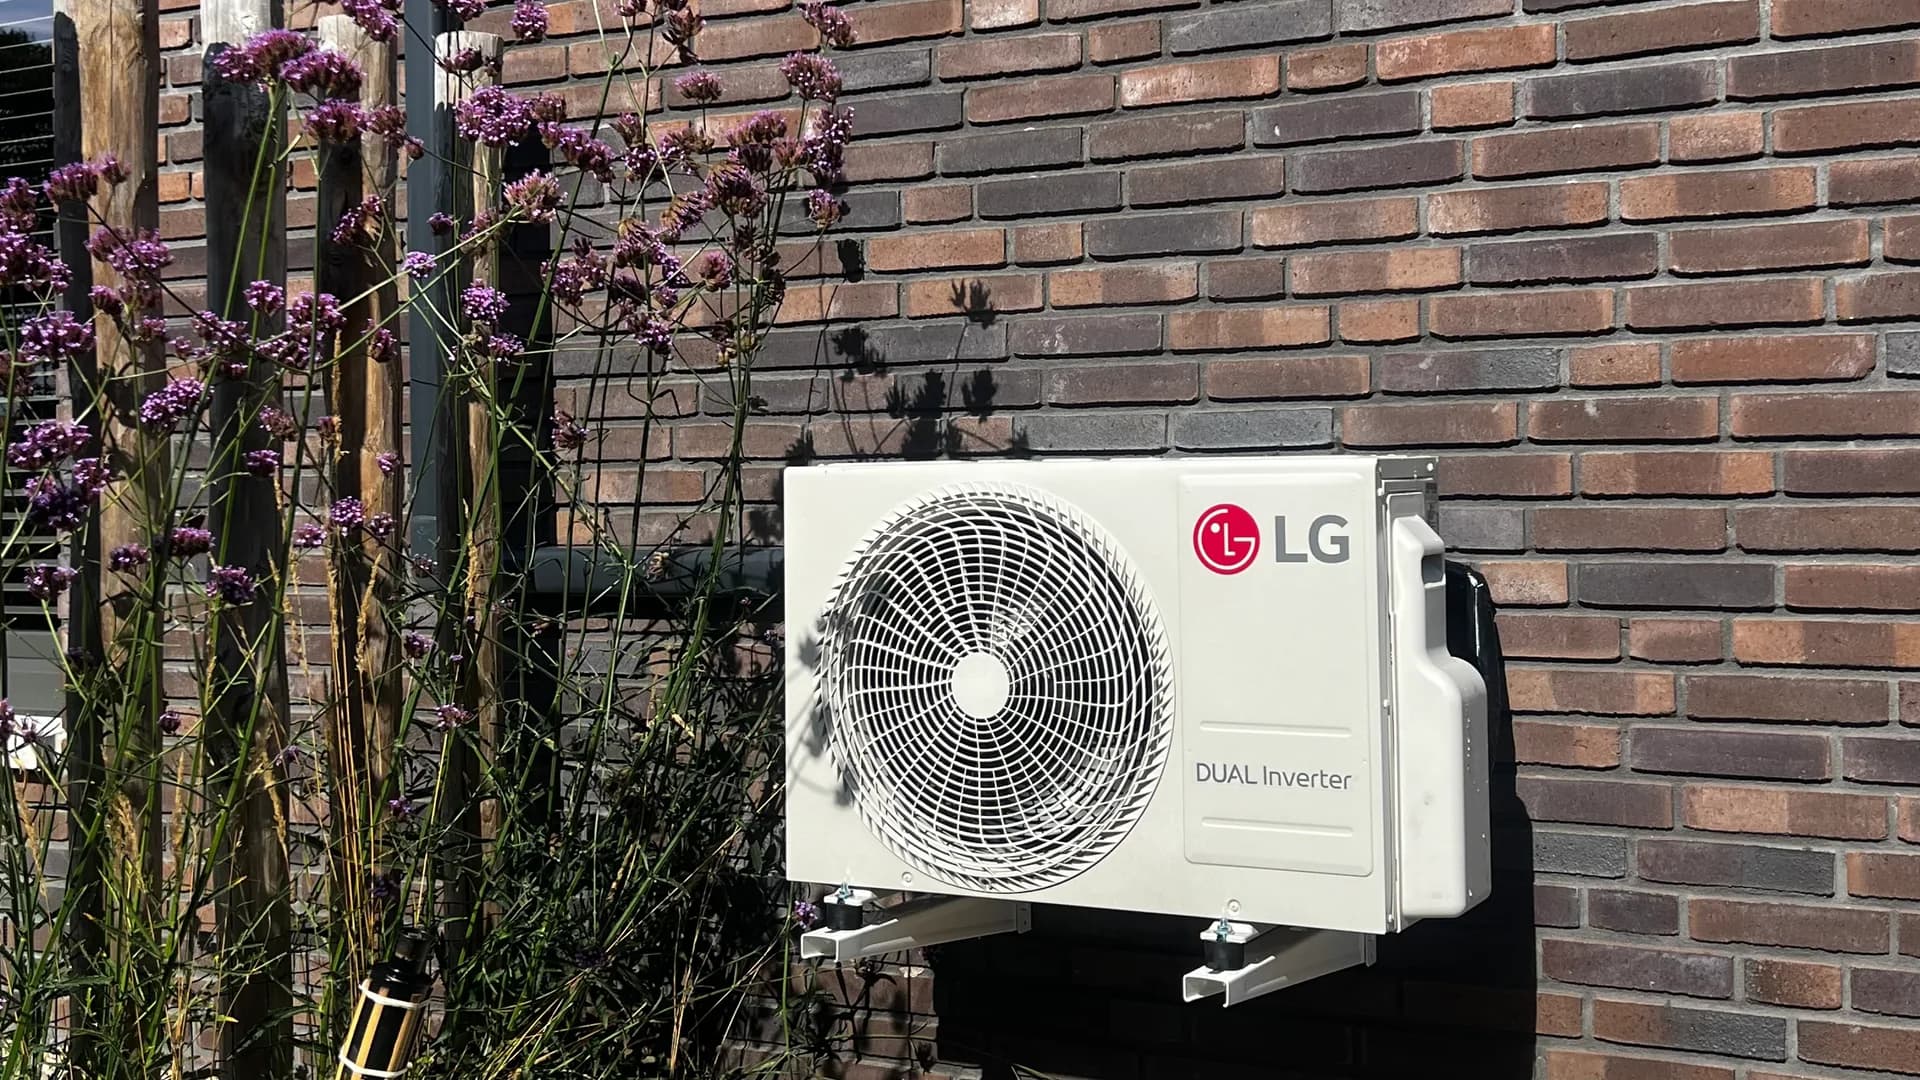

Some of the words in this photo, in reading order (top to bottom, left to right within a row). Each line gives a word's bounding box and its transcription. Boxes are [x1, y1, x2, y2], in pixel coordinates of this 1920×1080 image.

[1275, 514, 1350, 564] LG
[1196, 763, 1258, 785] DUAL
[1263, 766, 1352, 790] Inverter
